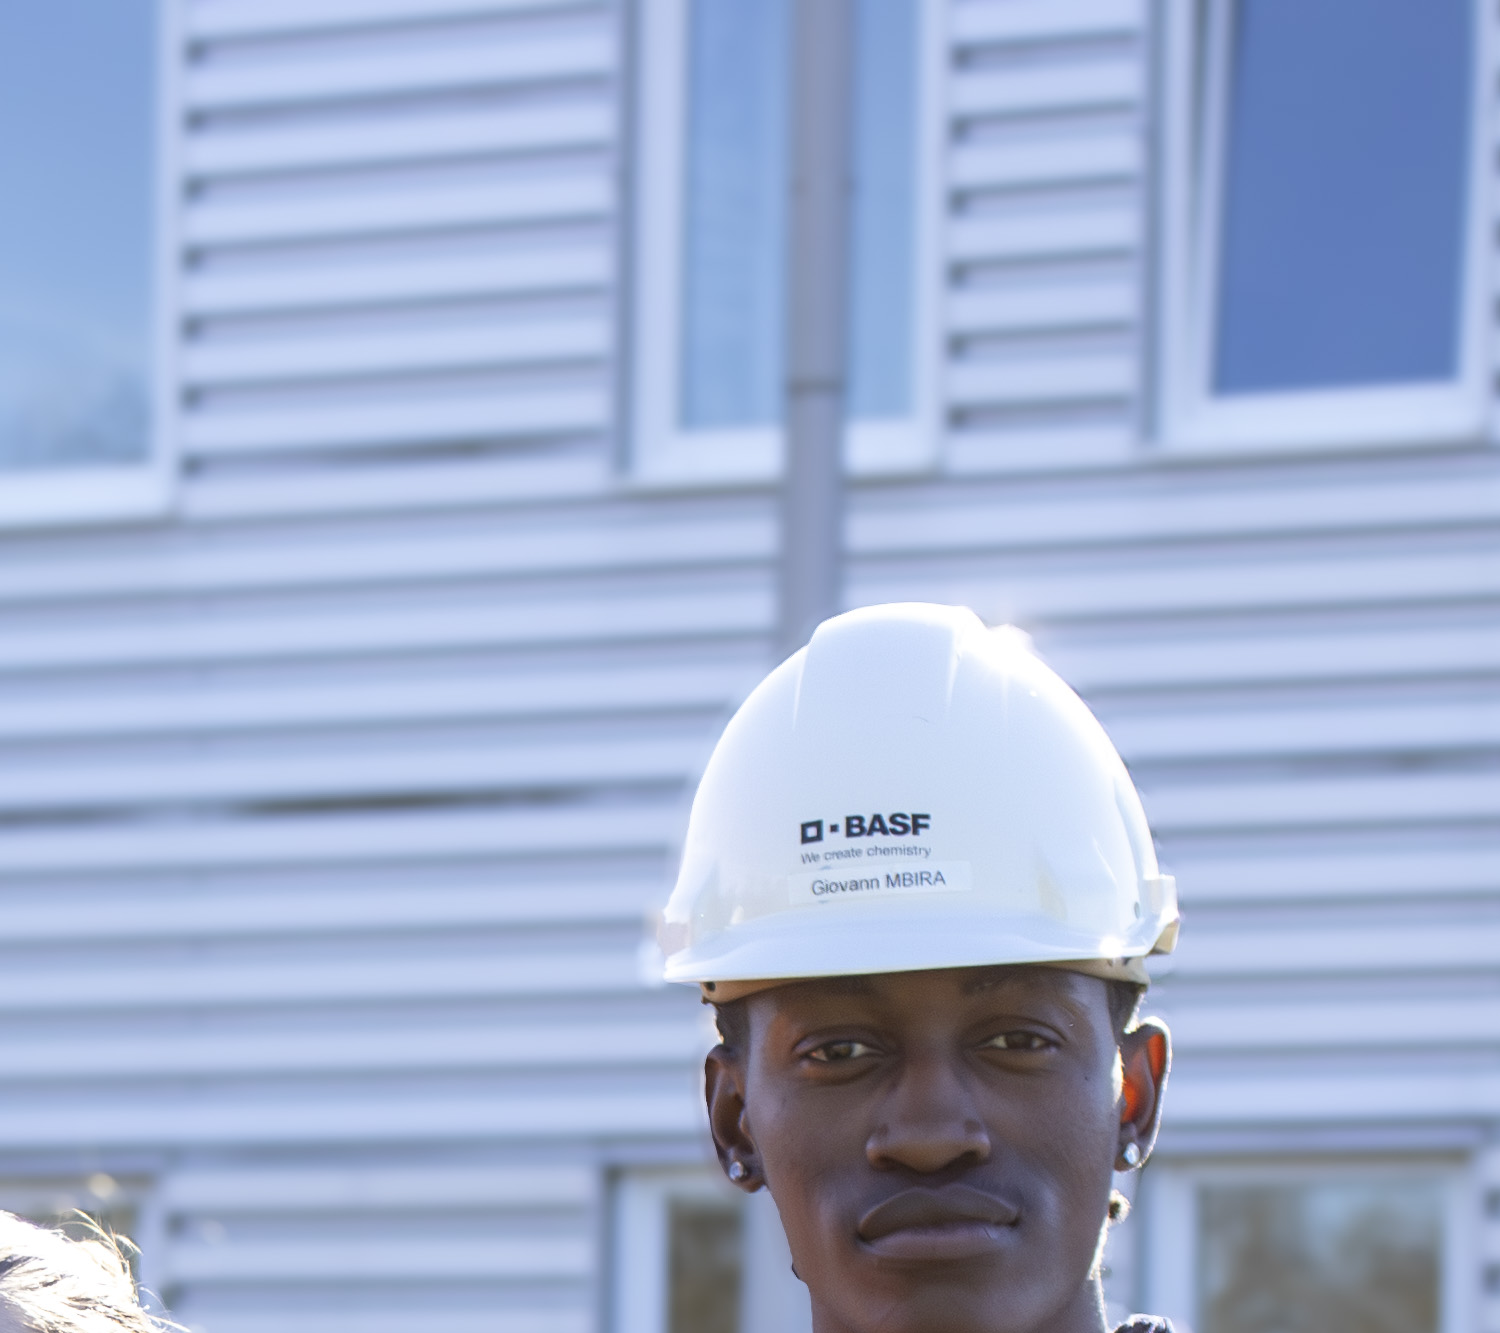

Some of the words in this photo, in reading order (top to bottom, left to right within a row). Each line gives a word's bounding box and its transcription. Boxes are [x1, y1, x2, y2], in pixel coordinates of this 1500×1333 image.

[845, 812, 931, 838] BASF
[800, 851, 821, 864] We
[824, 845, 863, 861] create
[866, 843, 932, 860] chemistry
[811, 877, 880, 896] Giovann
[885, 870, 946, 889] MBIRA
